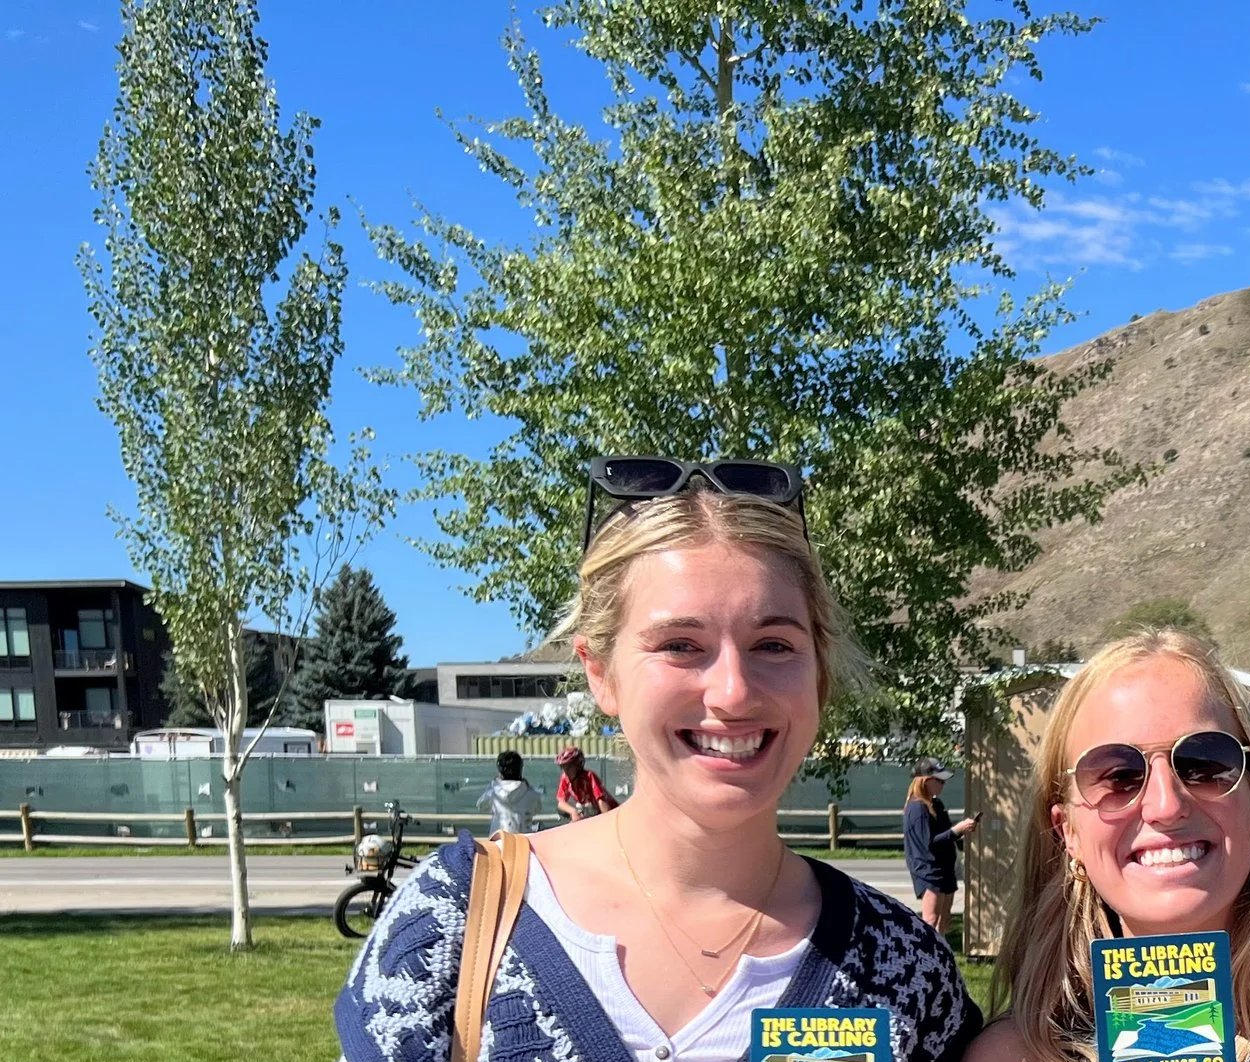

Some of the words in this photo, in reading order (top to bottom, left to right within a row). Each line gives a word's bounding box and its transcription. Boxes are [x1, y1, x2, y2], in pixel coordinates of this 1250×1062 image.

[1101, 948, 1136, 964] THE
[1141, 941, 1216, 962] LIBRARY
[1103, 963, 1123, 980] IS
[1128, 956, 1216, 978] CALLING
[760, 1018, 796, 1032] THE
[801, 1018, 877, 1032] LIBRARY
[761, 1032, 781, 1047] IS
[787, 1031, 877, 1047] CALLING
